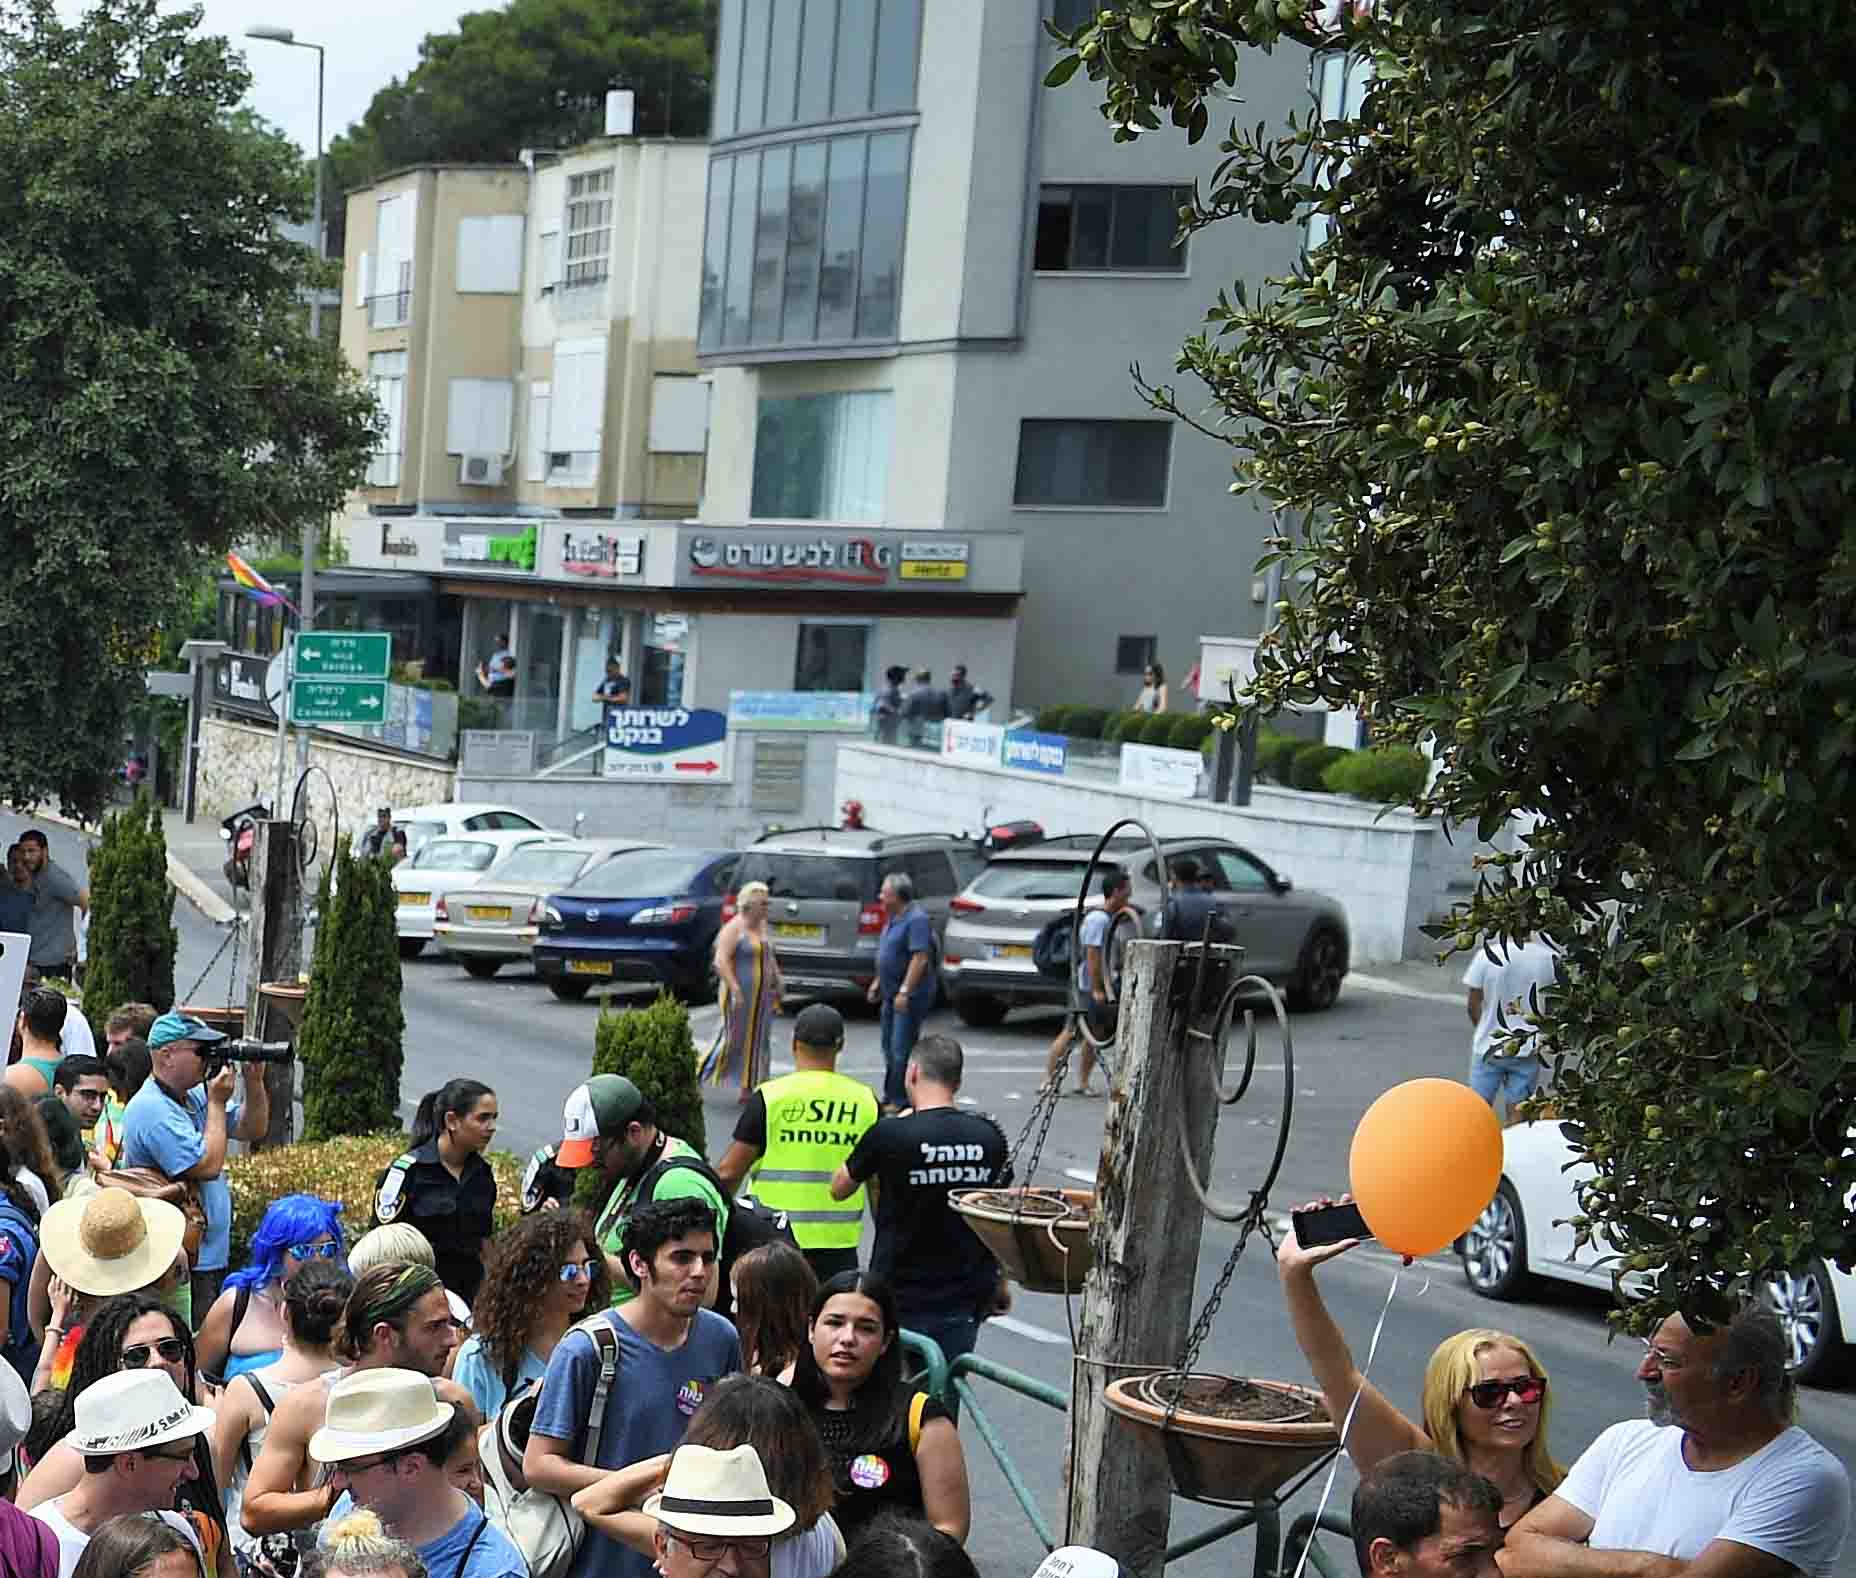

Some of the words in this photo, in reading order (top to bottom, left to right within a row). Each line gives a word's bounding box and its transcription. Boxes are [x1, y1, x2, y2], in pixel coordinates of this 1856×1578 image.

[808, 1099, 860, 1125] SIH
[780, 1127, 860, 1146] אבטחה
[920, 1142, 984, 1164] מנהל
[908, 1165, 992, 1186] אבטחה
